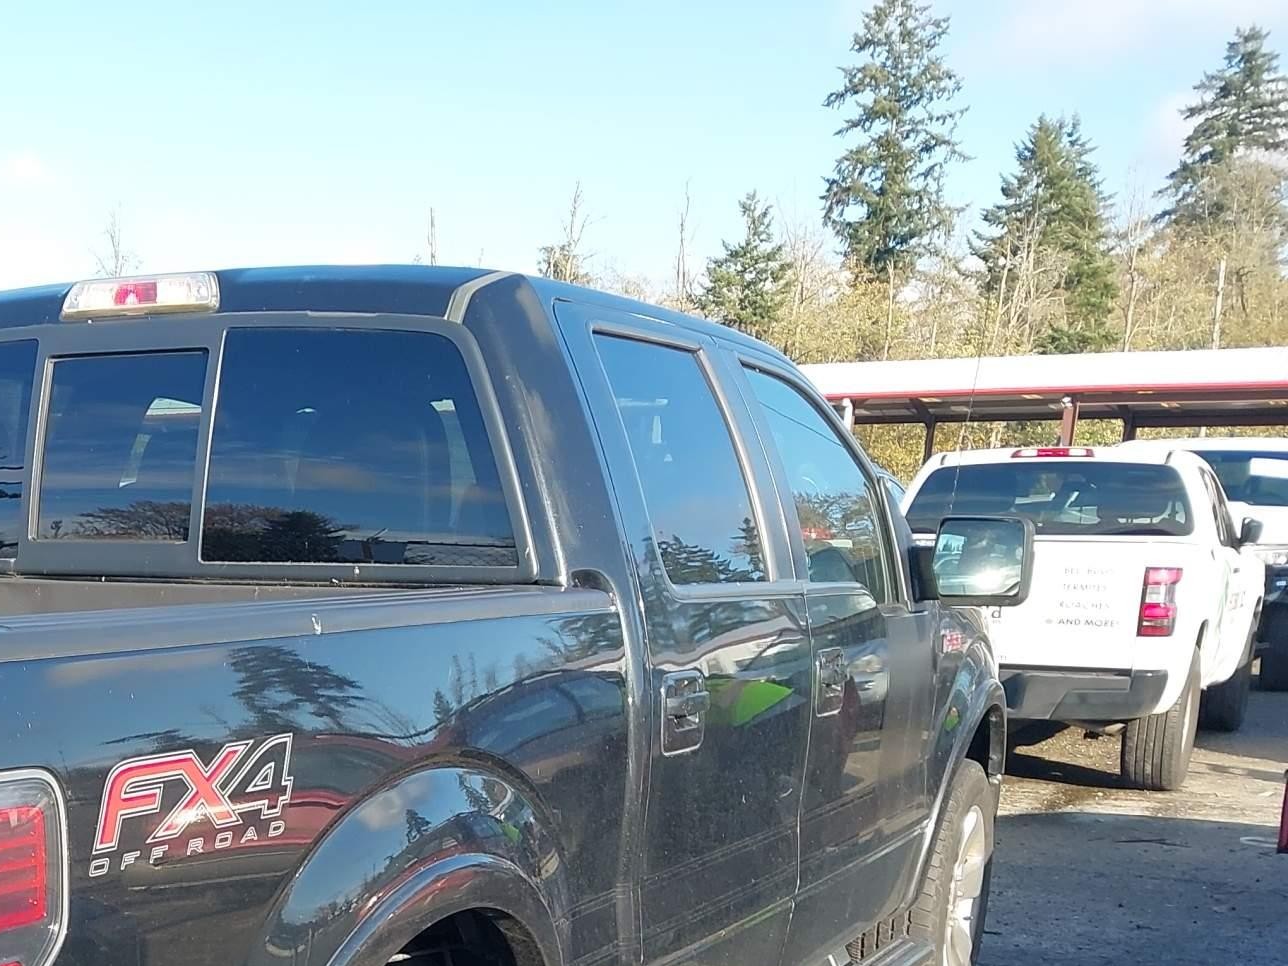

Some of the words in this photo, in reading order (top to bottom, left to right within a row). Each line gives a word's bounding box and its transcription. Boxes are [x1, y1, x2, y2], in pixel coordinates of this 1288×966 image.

[1057, 617, 1081, 625] AND
[92, 732, 294, 855] FX4
[88, 844, 169, 878] OFF
[186, 820, 287, 857] ROAD
